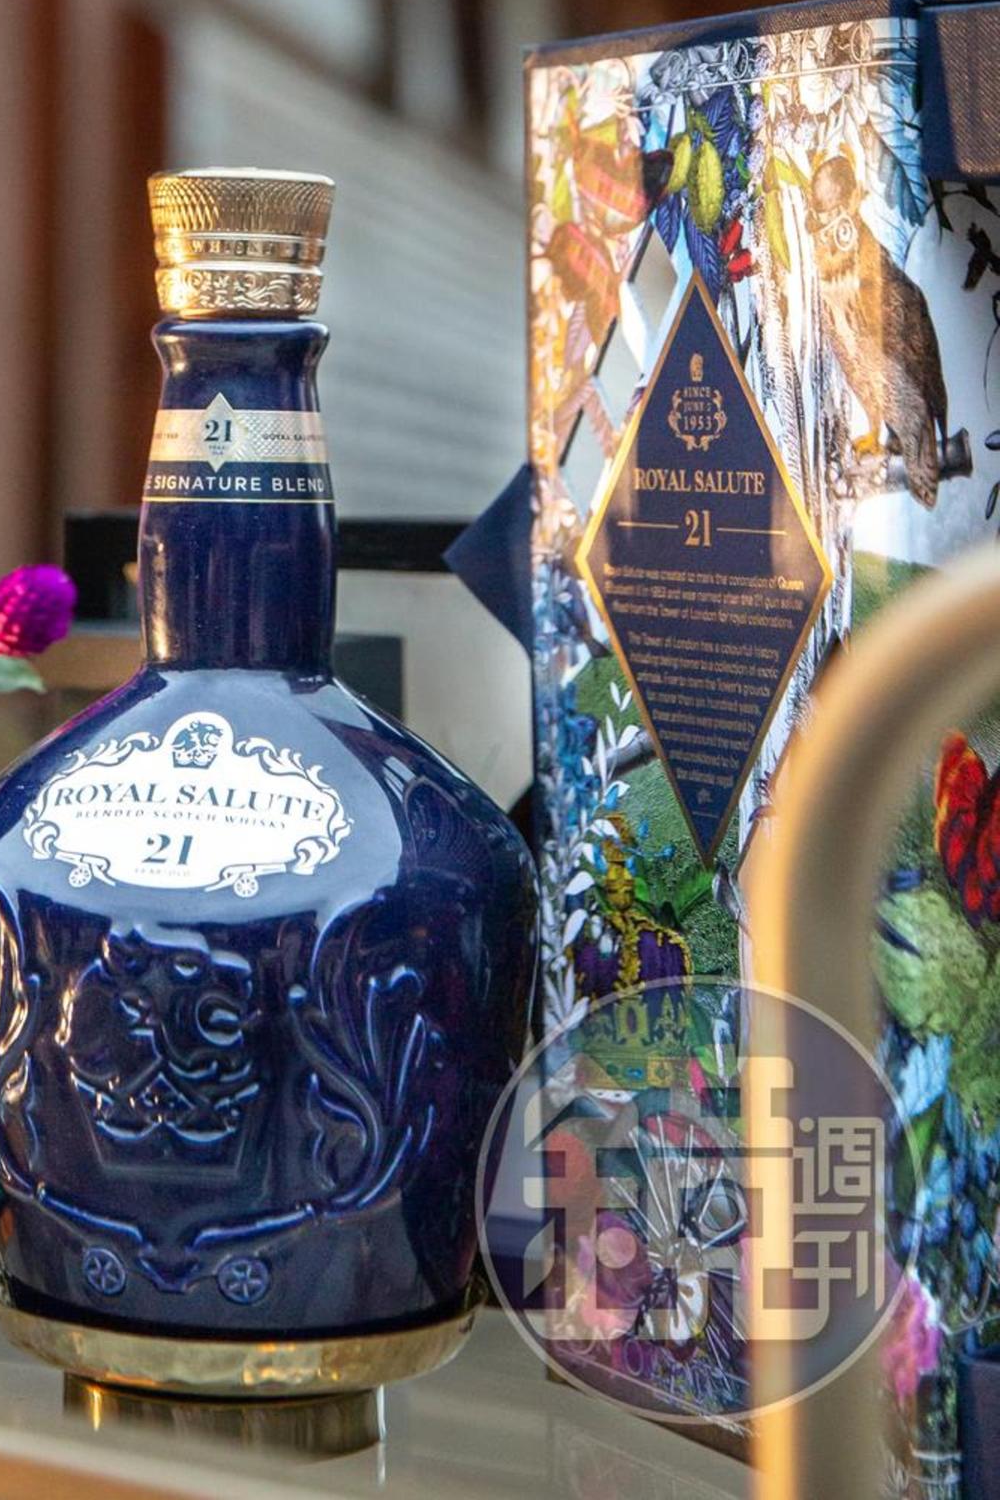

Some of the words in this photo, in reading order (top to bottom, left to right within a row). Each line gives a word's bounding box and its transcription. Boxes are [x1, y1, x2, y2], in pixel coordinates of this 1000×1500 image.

[682, 386, 711, 398] SINCE
[204, 419, 232, 442] 21
[682, 415, 712, 431] 1953
[154, 475, 262, 492] SIGNATURE
[271, 476, 325, 493] BLEND
[634, 467, 692, 493] ROYAL
[694, 469, 765, 495] SALUTE
[684, 509, 711, 547] 21
[53, 782, 168, 807] ROYAL
[175, 783, 326, 822] SALUTE
[74, 808, 145, 819] BLENDED
[152, 810, 217, 822] SCOTCH
[225, 814, 287, 830] WHISKY
[140, 833, 194, 866] 21
